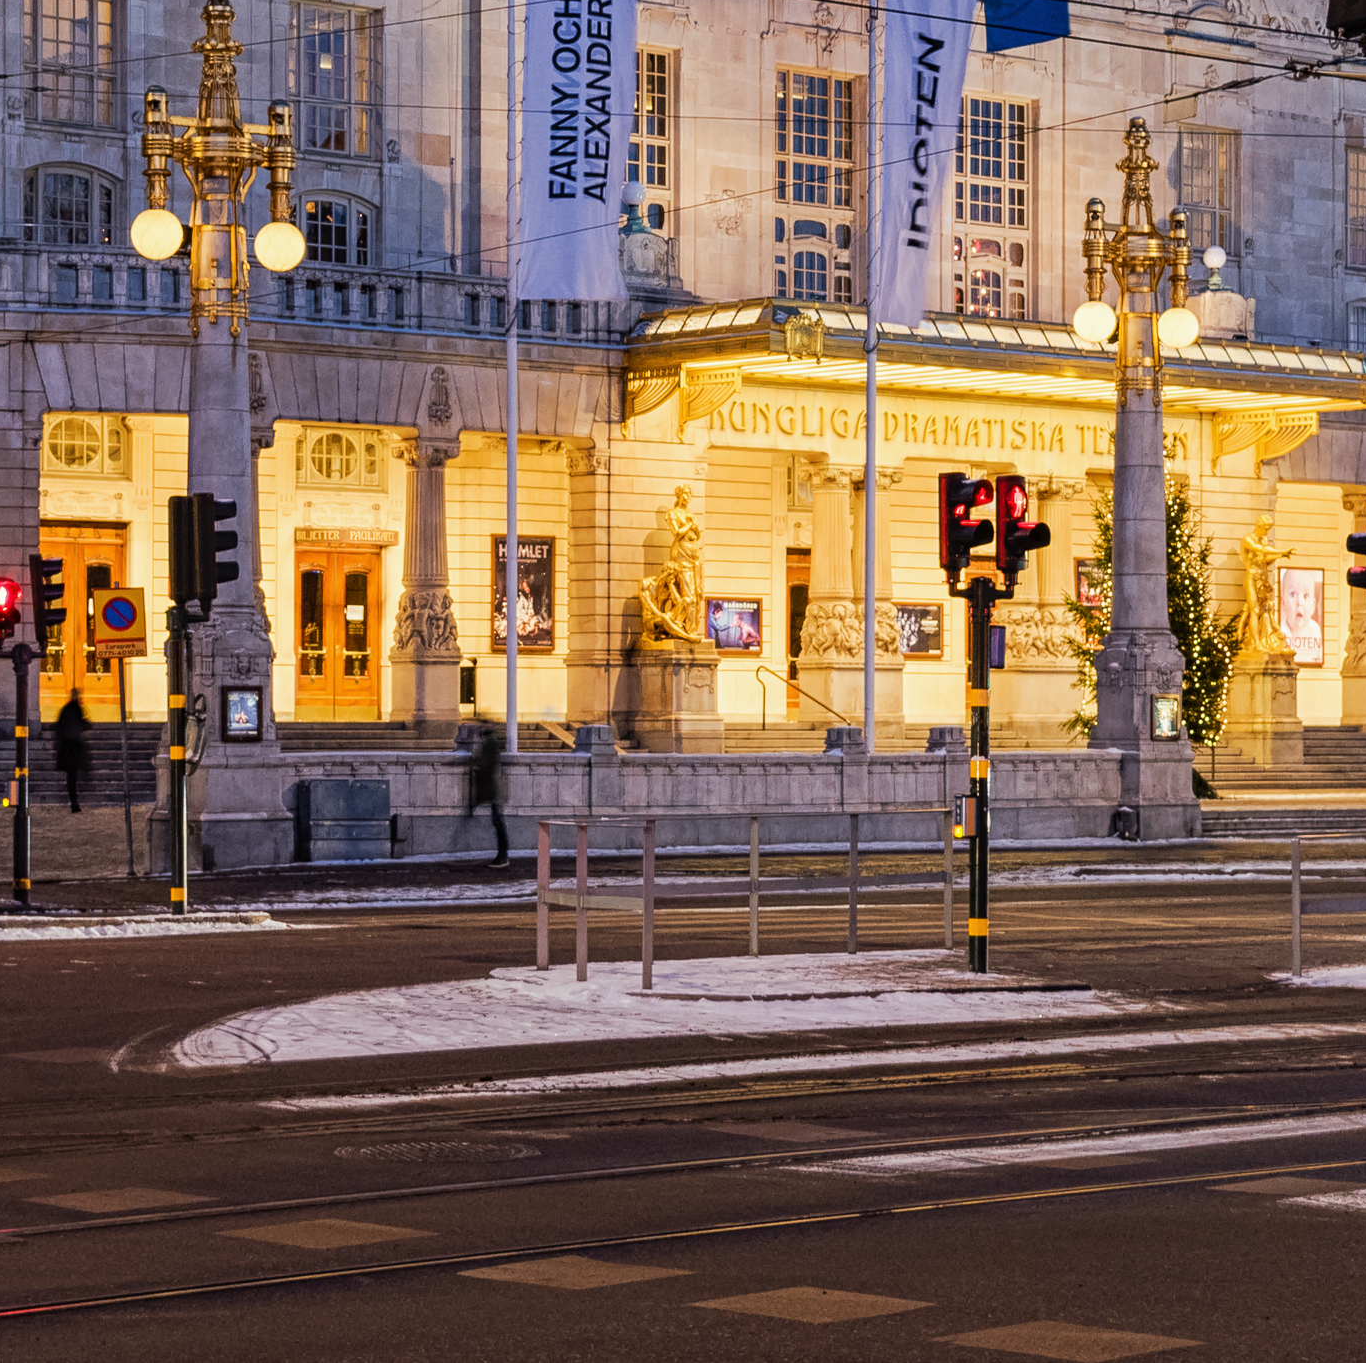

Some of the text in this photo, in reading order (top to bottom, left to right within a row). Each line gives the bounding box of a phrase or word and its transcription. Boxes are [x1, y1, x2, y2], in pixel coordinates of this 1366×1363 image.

[548, 83, 580, 199] FANNY
[906, 32, 945, 251] IDIOTEN
[884, 410, 1065, 453] DRAMATISKA
[296, 530, 340, 541] BILJETTER
[498, 543, 549, 559] HMLET
[1285, 636, 1321, 649] DIOTEN
